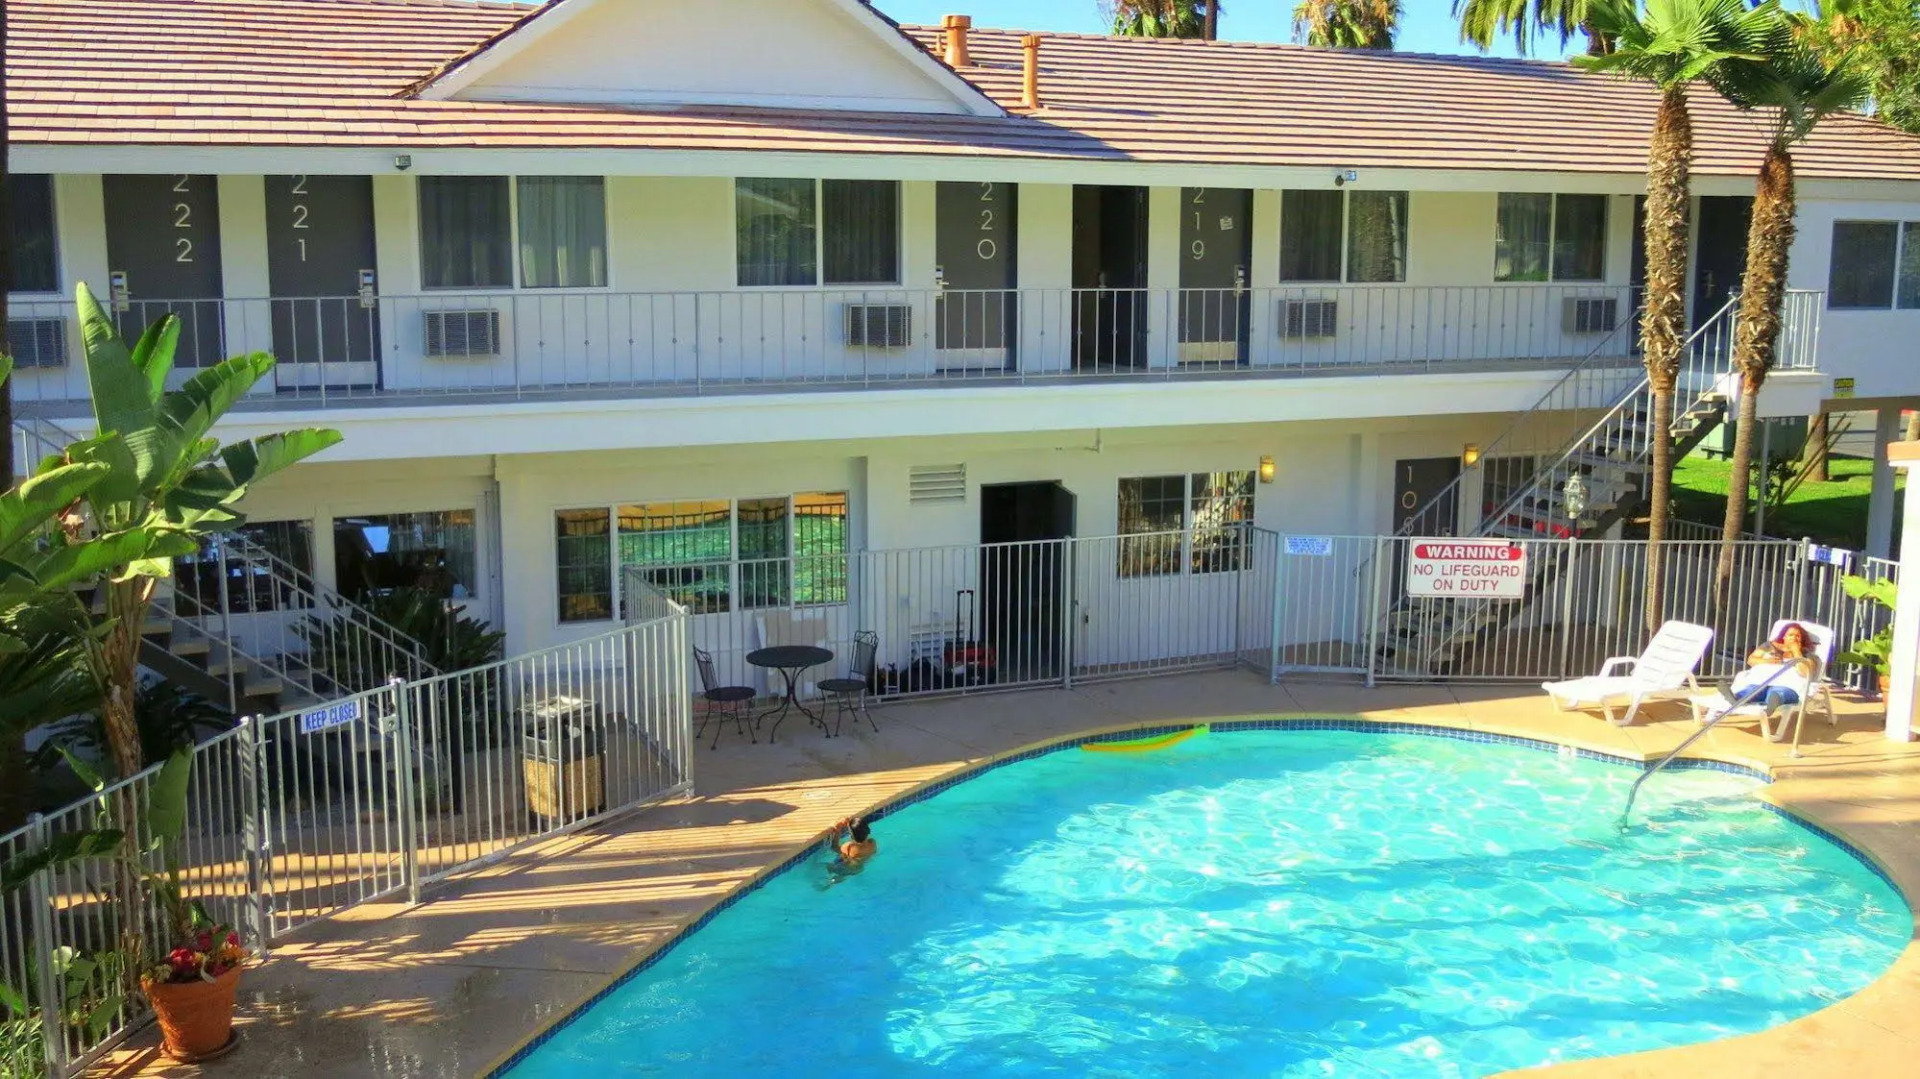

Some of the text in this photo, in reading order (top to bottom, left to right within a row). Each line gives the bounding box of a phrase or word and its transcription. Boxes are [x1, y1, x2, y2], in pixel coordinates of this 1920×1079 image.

[172, 174, 193, 262] 222
[291, 174, 309, 262] 221
[977, 181, 996, 260] 220
[1191, 186, 1205, 260] 219
[1413, 563, 1520, 577] NO LIFEGUARD
[1425, 545, 1510, 560] WARNING
[1433, 578, 1499, 591] ON DUTY
[305, 701, 357, 730] KEEP CLOSED
